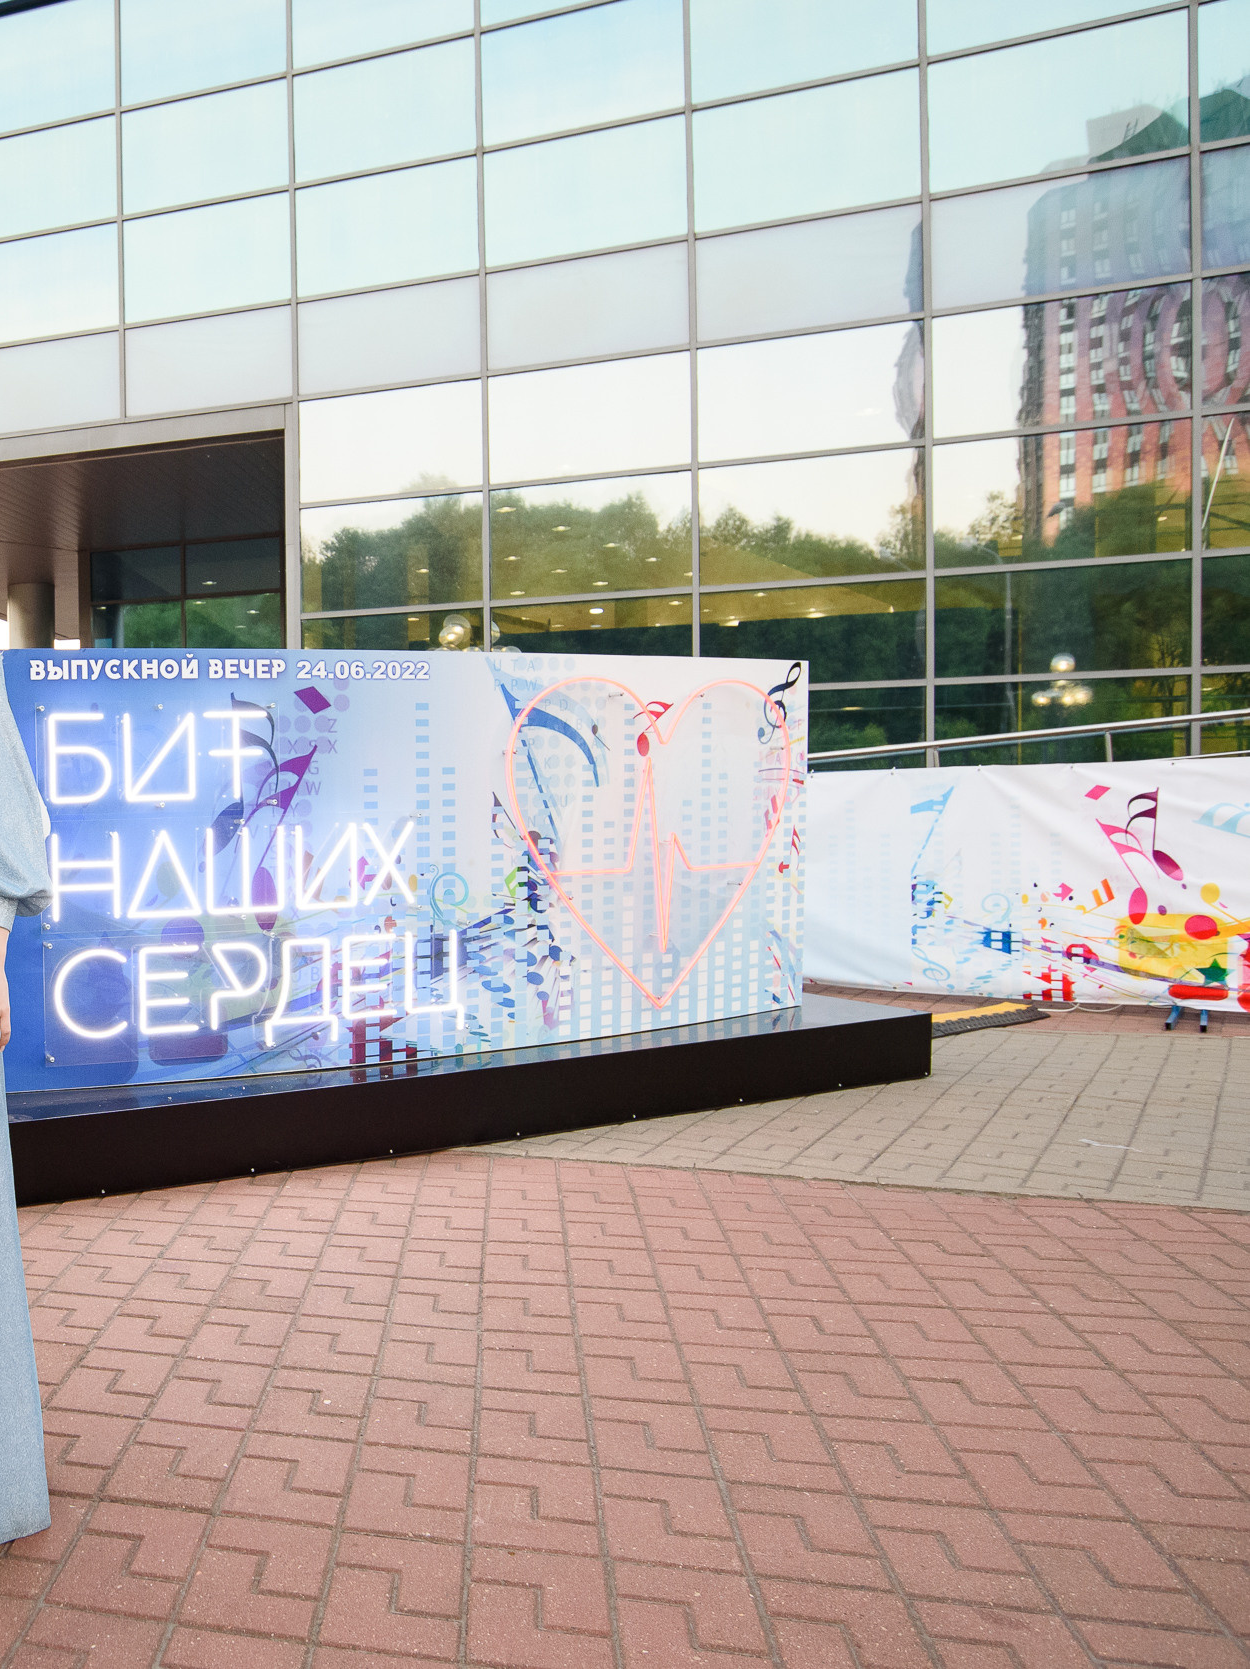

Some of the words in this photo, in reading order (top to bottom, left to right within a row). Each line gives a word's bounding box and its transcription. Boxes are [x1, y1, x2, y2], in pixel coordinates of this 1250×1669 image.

[30, 654, 197, 681] ВЫПУСКНОЙ
[208, 659, 286, 680] ВЕЧЕР
[296, 660, 430, 680] 24.06.2022
[45, 709, 269, 805] БИТ
[50, 819, 416, 923] НАШИХ
[52, 928, 467, 1049] СЕРДЕЦ
